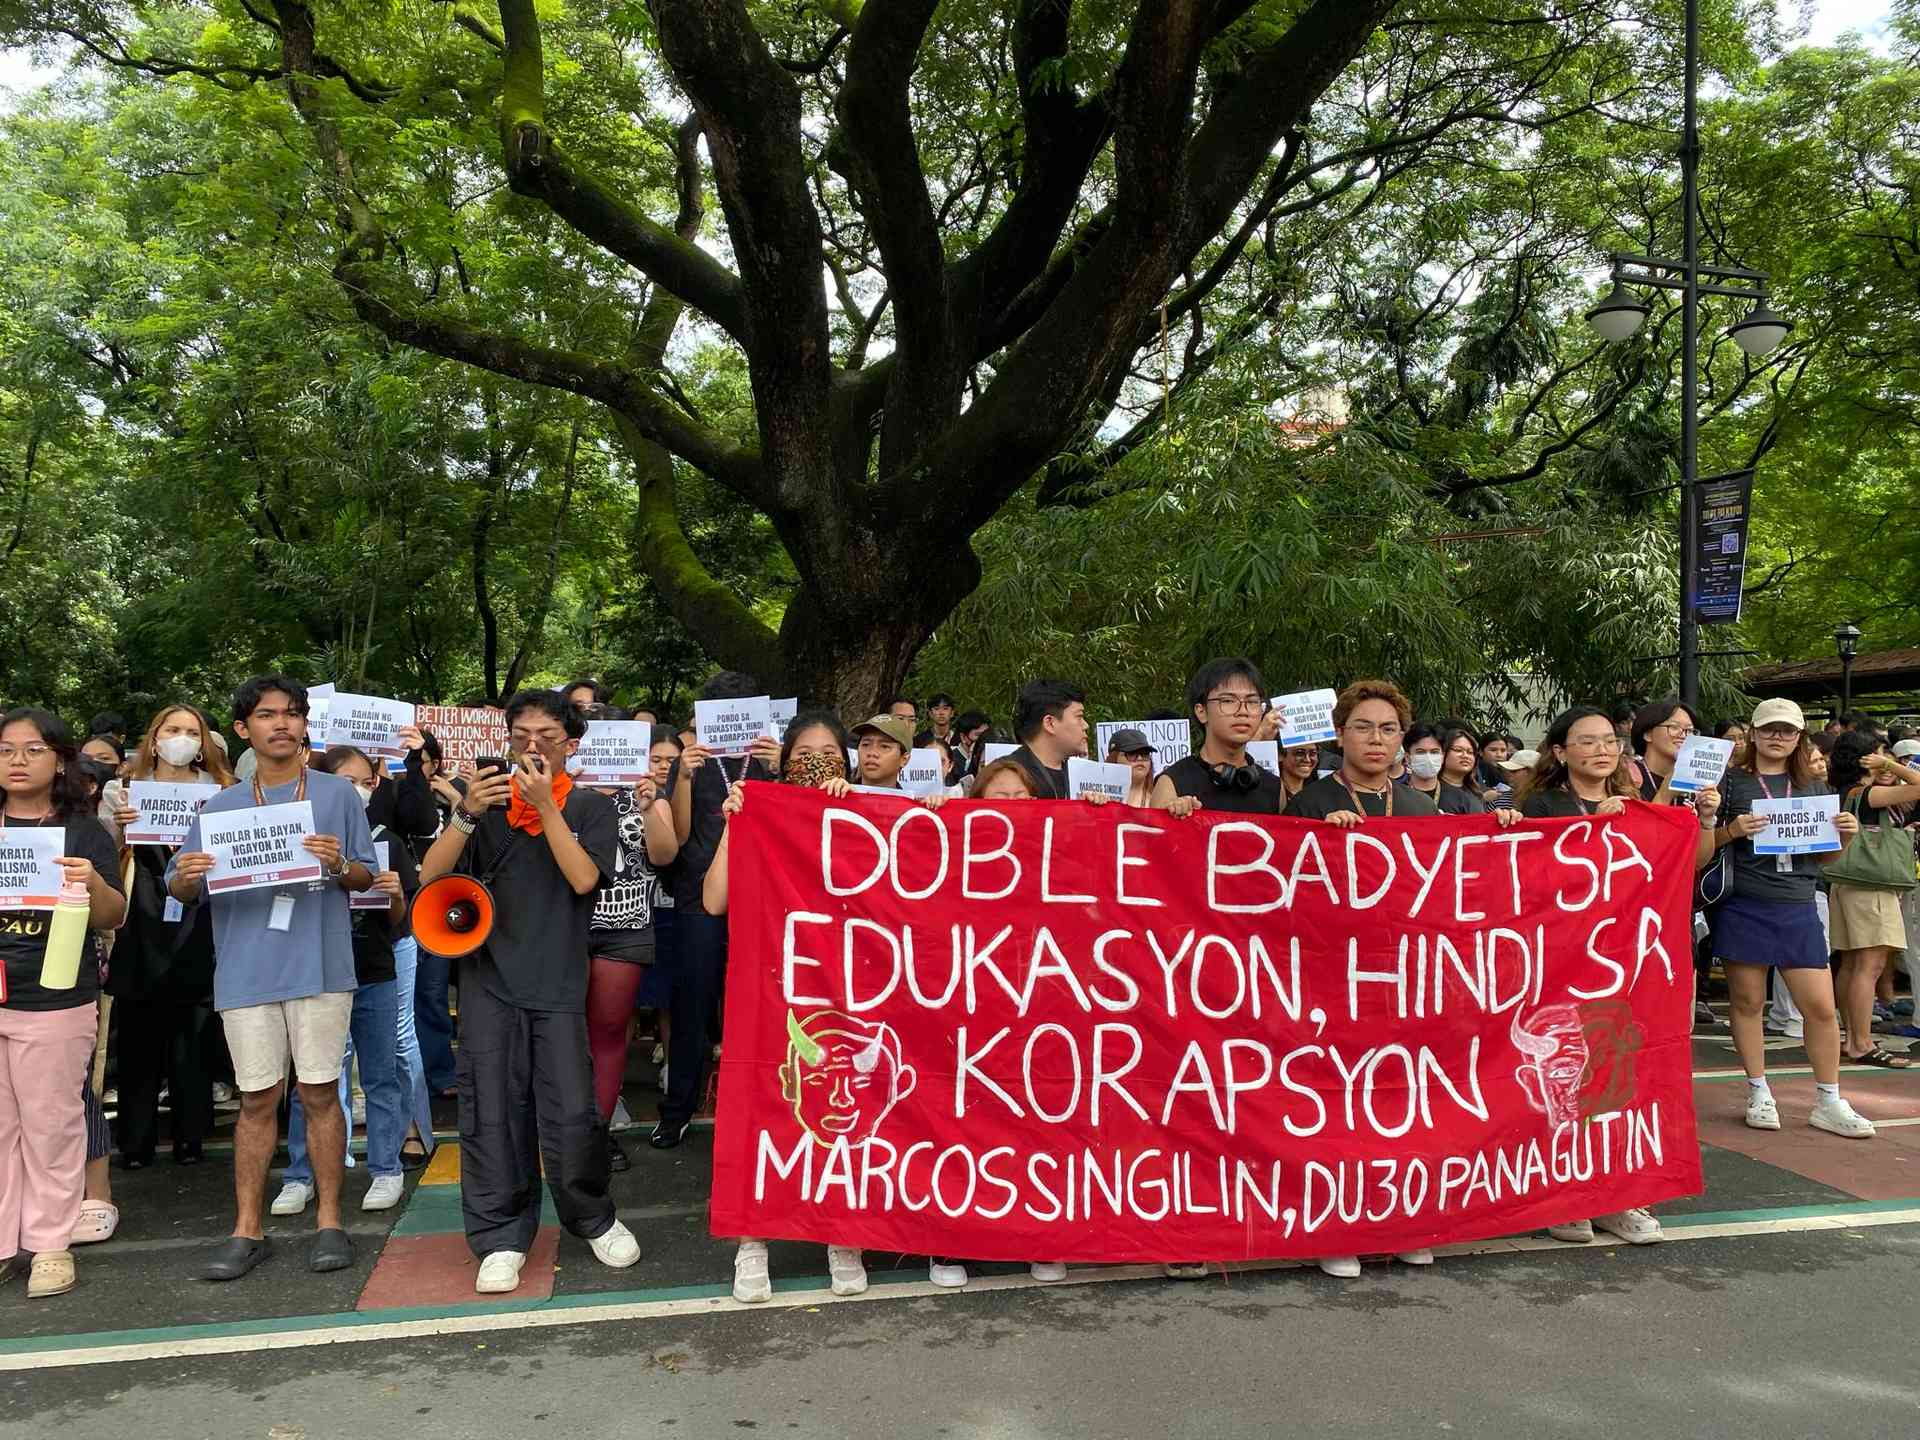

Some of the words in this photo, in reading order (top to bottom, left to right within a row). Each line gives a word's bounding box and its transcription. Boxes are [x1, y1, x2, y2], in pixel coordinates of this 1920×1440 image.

[417, 704, 458, 724] BETTER
[332, 718, 371, 730] PROTESTA
[373, 721, 388, 732] ANG
[910, 768, 937, 781] KURAP!
[140, 799, 187, 812] MARCOS
[1767, 811, 1810, 825] MARCOS
[1812, 811, 1828, 823] JR.
[210, 829, 251, 846] ISKOLAR
[253, 827, 268, 839] NG
[270, 822, 306, 836] BAYAN,
[1777, 825, 1819, 838] PALPAK!
[232, 841, 273, 857] NGAYON
[275, 838, 287, 850] AY
[230, 850, 295, 869] LUMALABAN!
[822, 806, 1165, 907] DOBLE
[1208, 821, 1544, 922] BADYET
[1553, 820, 1654, 911] SA
[783, 911, 1327, 1039] EDUKASYON,
[1347, 923, 1544, 1018] HINDI
[1567, 906, 1676, 999] SA
[954, 1022, 1490, 1138] KORAPSYON
[1438, 1102, 1664, 1212] PANAGUTIN
